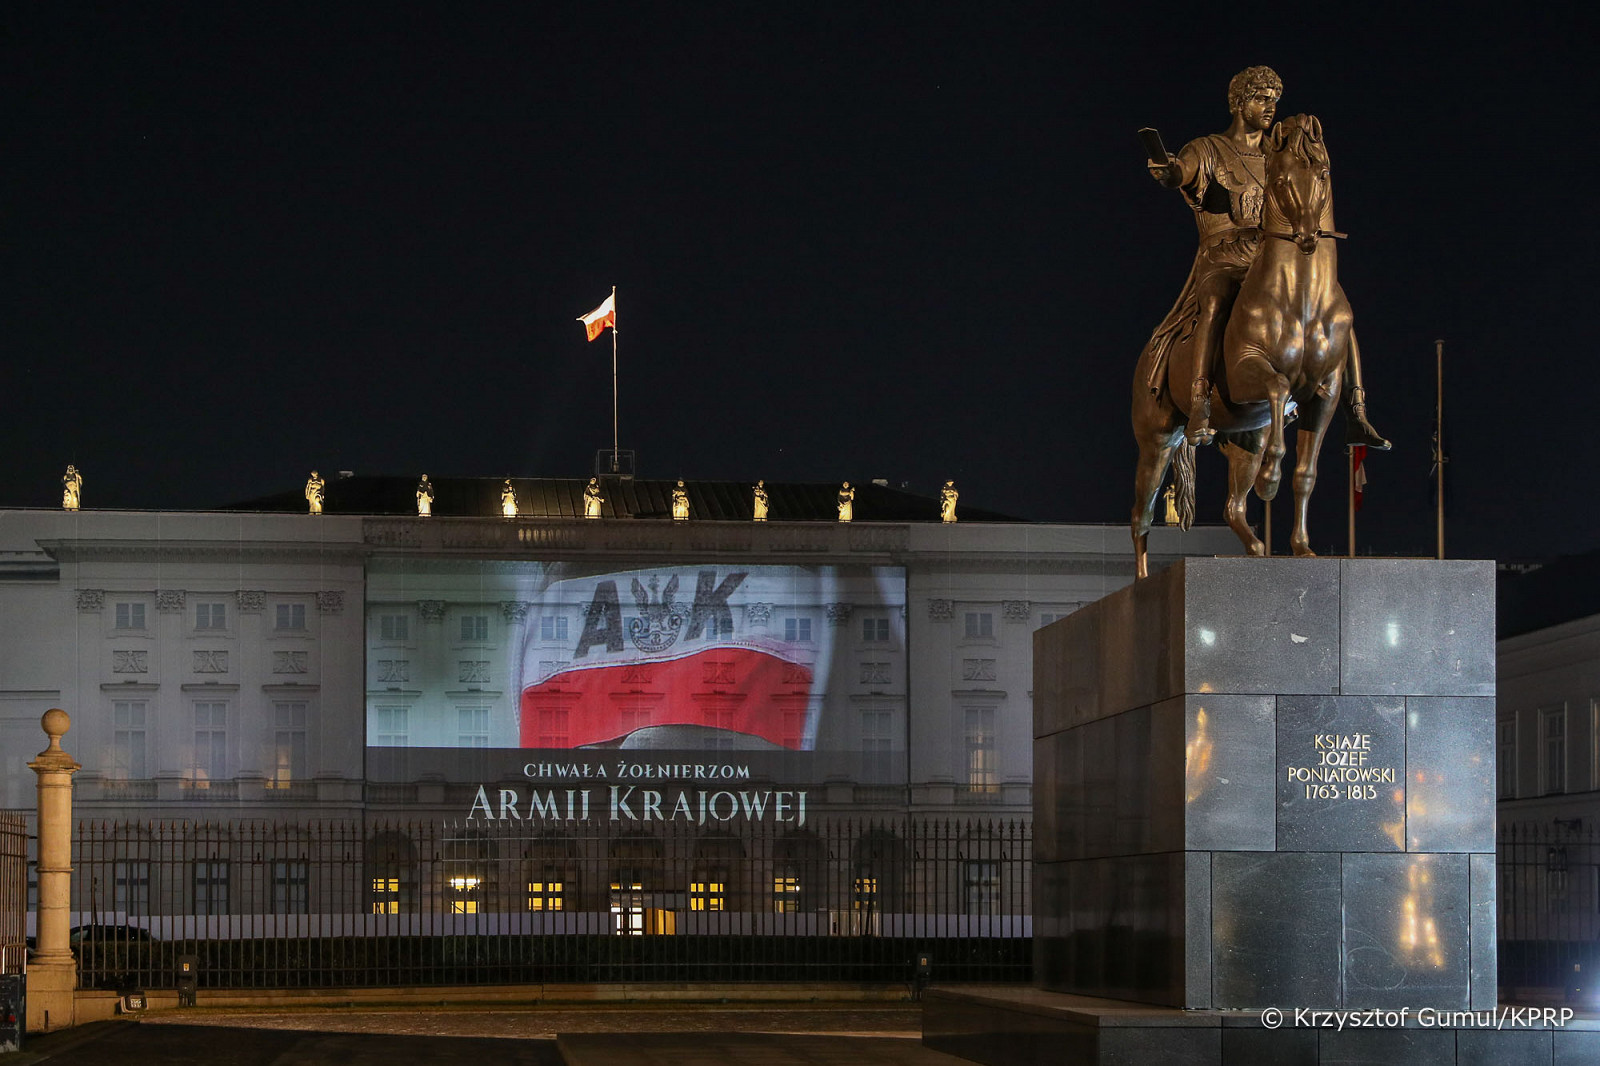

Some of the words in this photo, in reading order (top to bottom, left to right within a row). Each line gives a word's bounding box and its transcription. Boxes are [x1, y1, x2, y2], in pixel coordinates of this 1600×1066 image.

[573, 580, 624, 659] A
[683, 570, 749, 641] K
[1314, 732, 1371, 752] KSIĄŻĘ
[1318, 749, 1368, 766] JÓZEF
[523, 763, 608, 778] CHWAŁA
[617, 761, 751, 779] ŻOŁNIERZOM
[1287, 767, 1395, 783] PONIATOWSKI
[1306, 784, 1377, 800] 1763-1813
[467, 785, 592, 821] ARMII
[609, 785, 808, 827] KRAJOWEJ
